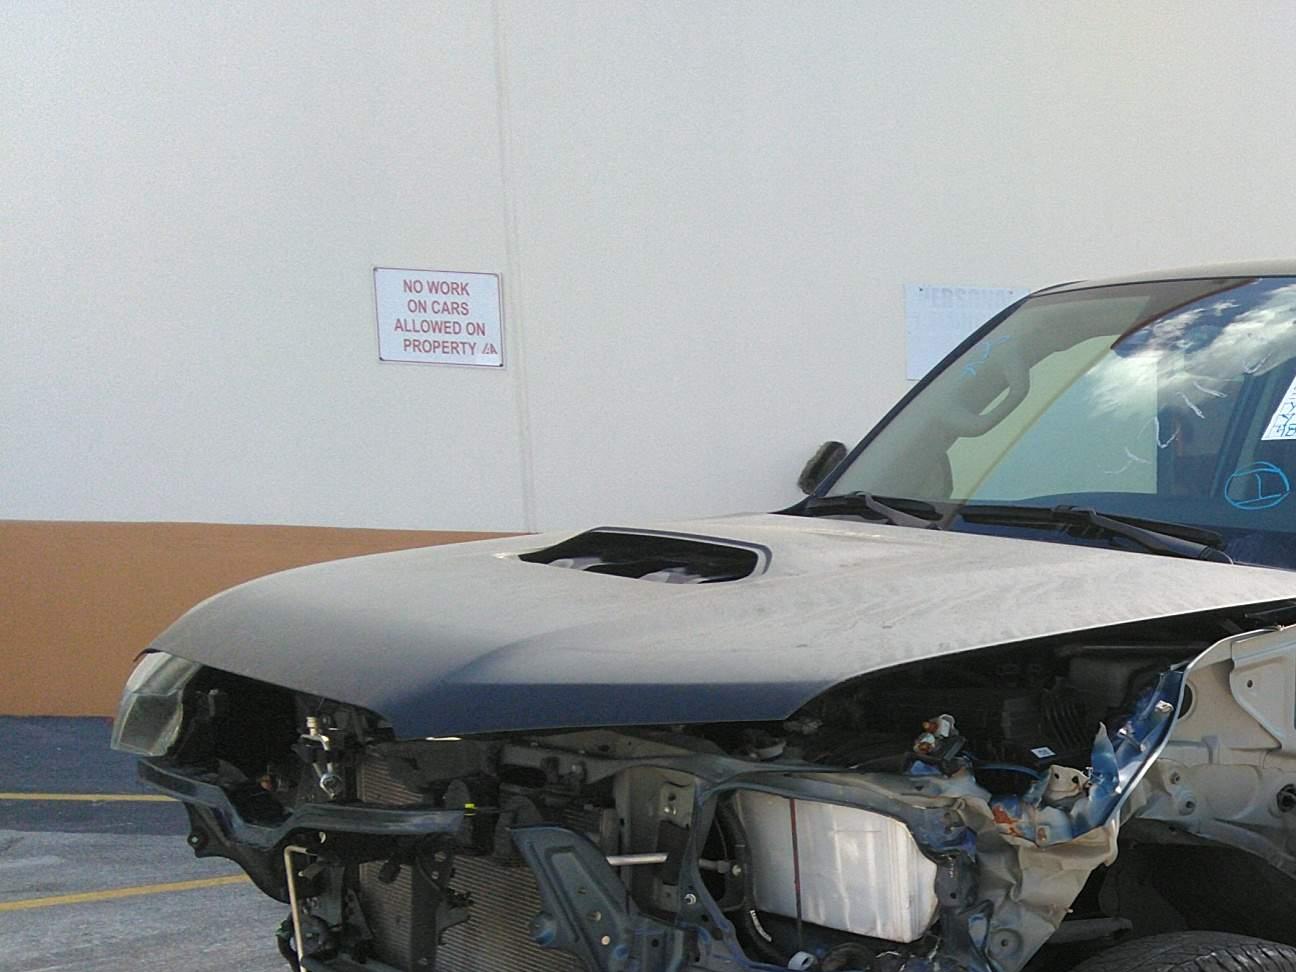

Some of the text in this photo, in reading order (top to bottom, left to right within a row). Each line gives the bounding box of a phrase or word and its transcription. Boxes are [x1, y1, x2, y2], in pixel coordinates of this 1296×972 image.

[403, 279, 471, 297] NO WORK
[407, 299, 470, 316] ON CARS
[394, 318, 486, 337] ALLOWED ON
[403, 338, 477, 356] PROPERTY
